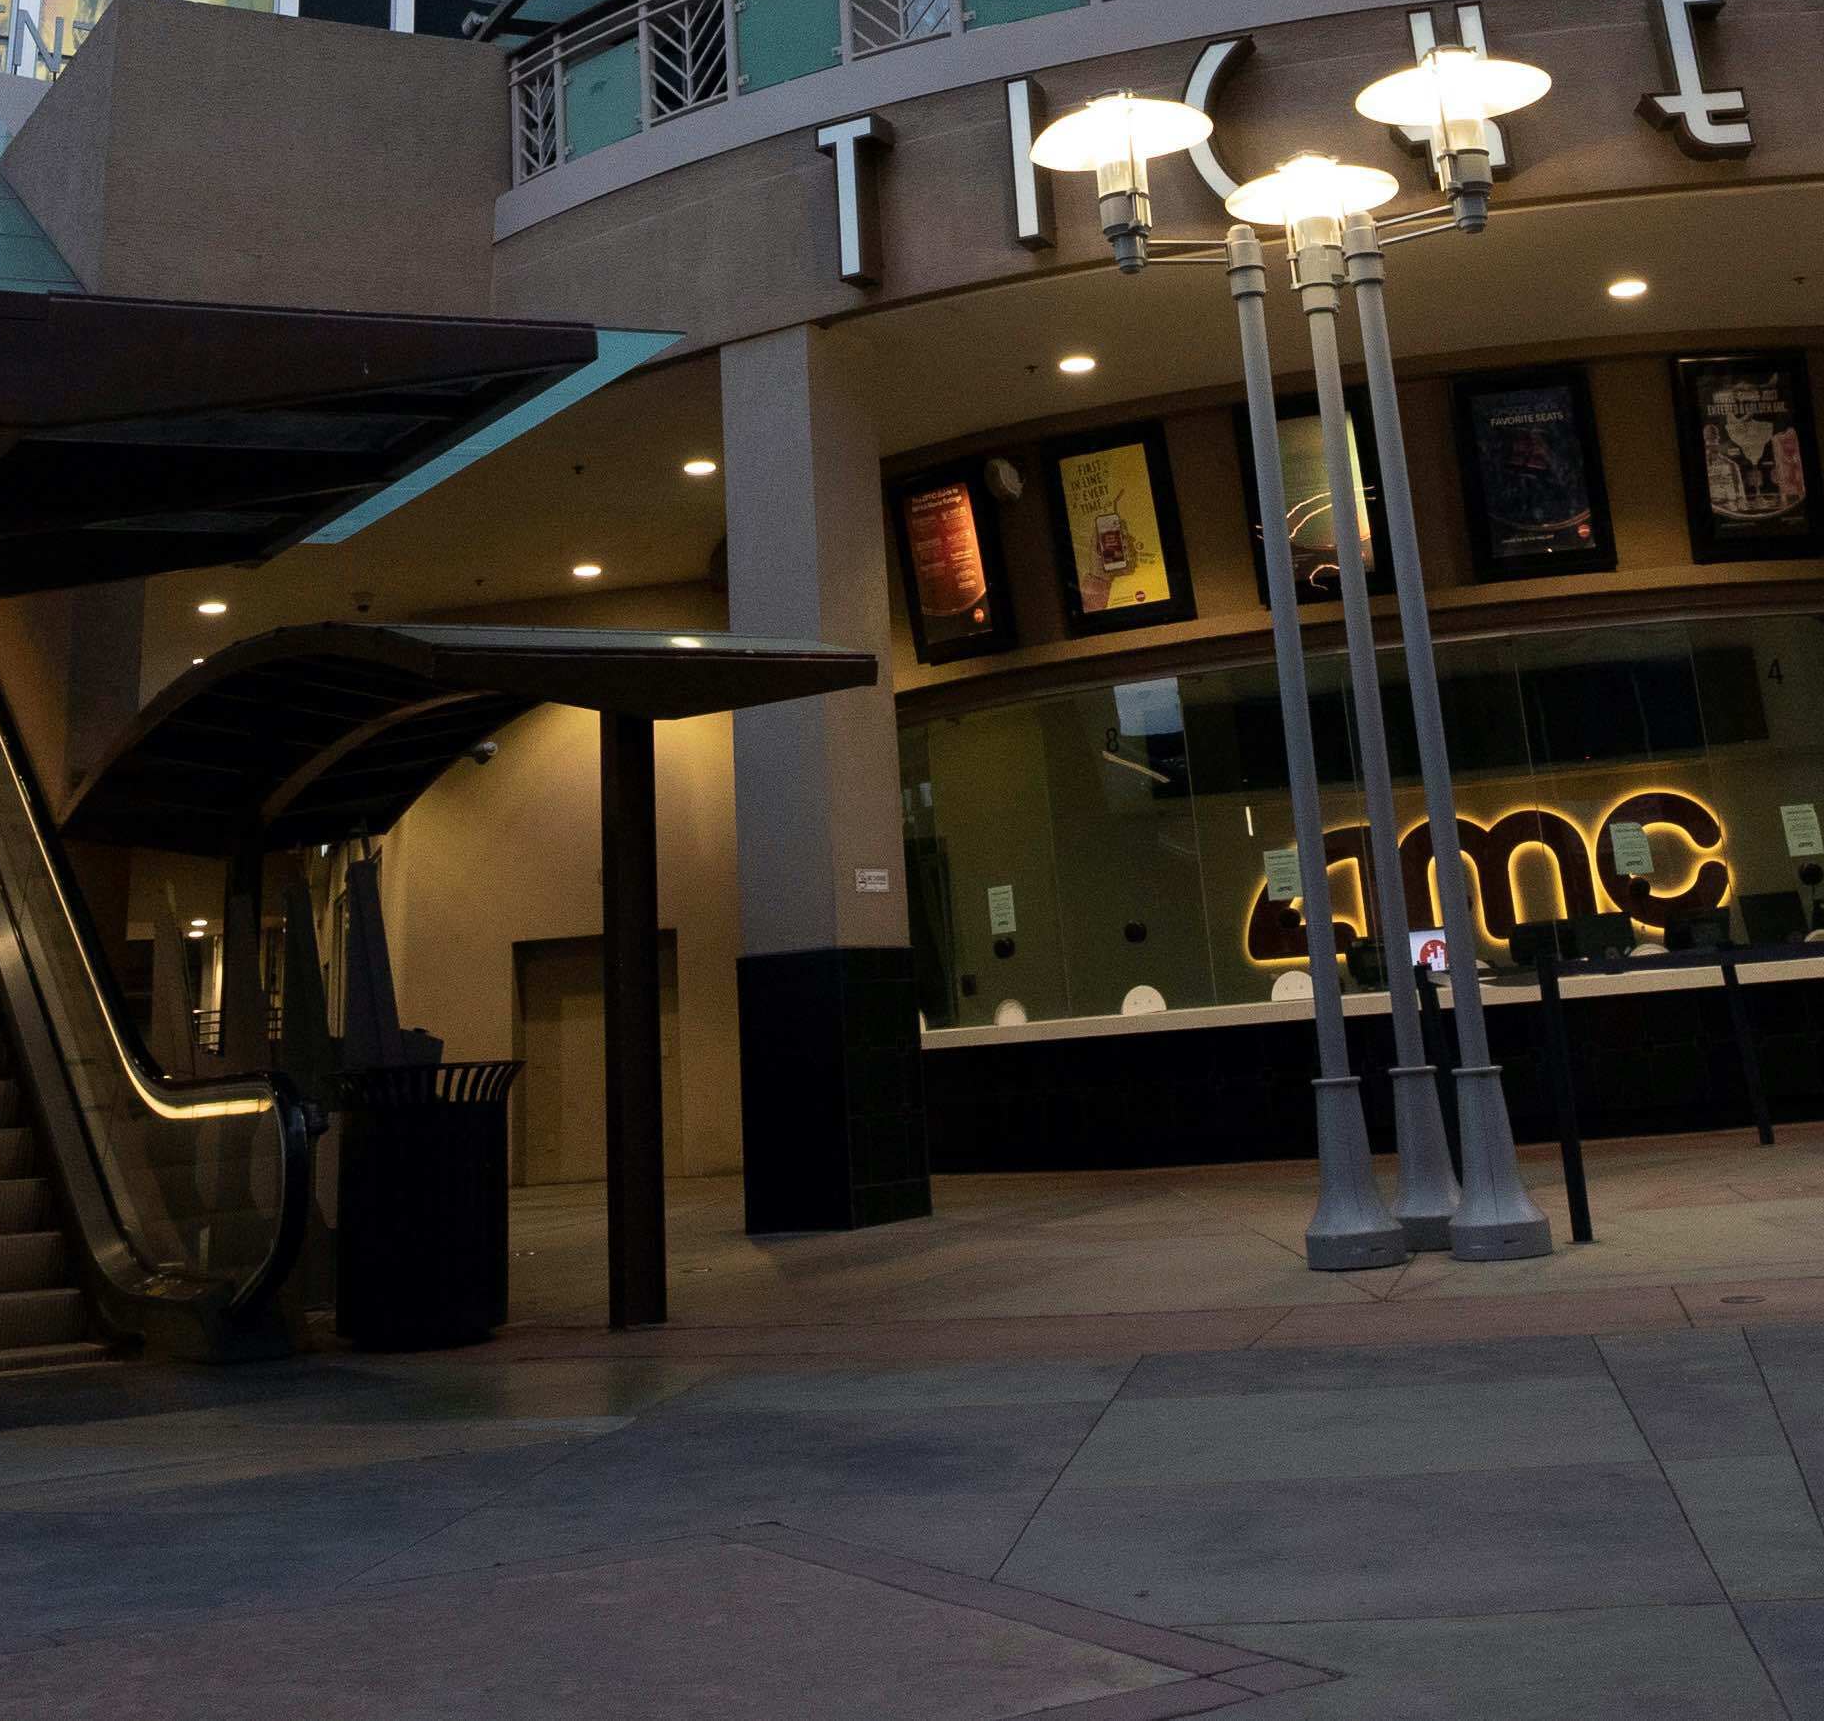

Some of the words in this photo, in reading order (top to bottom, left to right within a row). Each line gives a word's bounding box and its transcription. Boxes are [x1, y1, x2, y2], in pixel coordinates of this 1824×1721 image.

[1488, 413, 1535, 427] FAVORITE
[1535, 410, 1564, 423] SEATS
[1078, 459, 1101, 476] FIRST
[1082, 473, 1103, 488] LINE
[1082, 484, 1109, 501] EVERY
[1767, 659, 1784, 684] 4
[1104, 727, 1120, 753] 8
